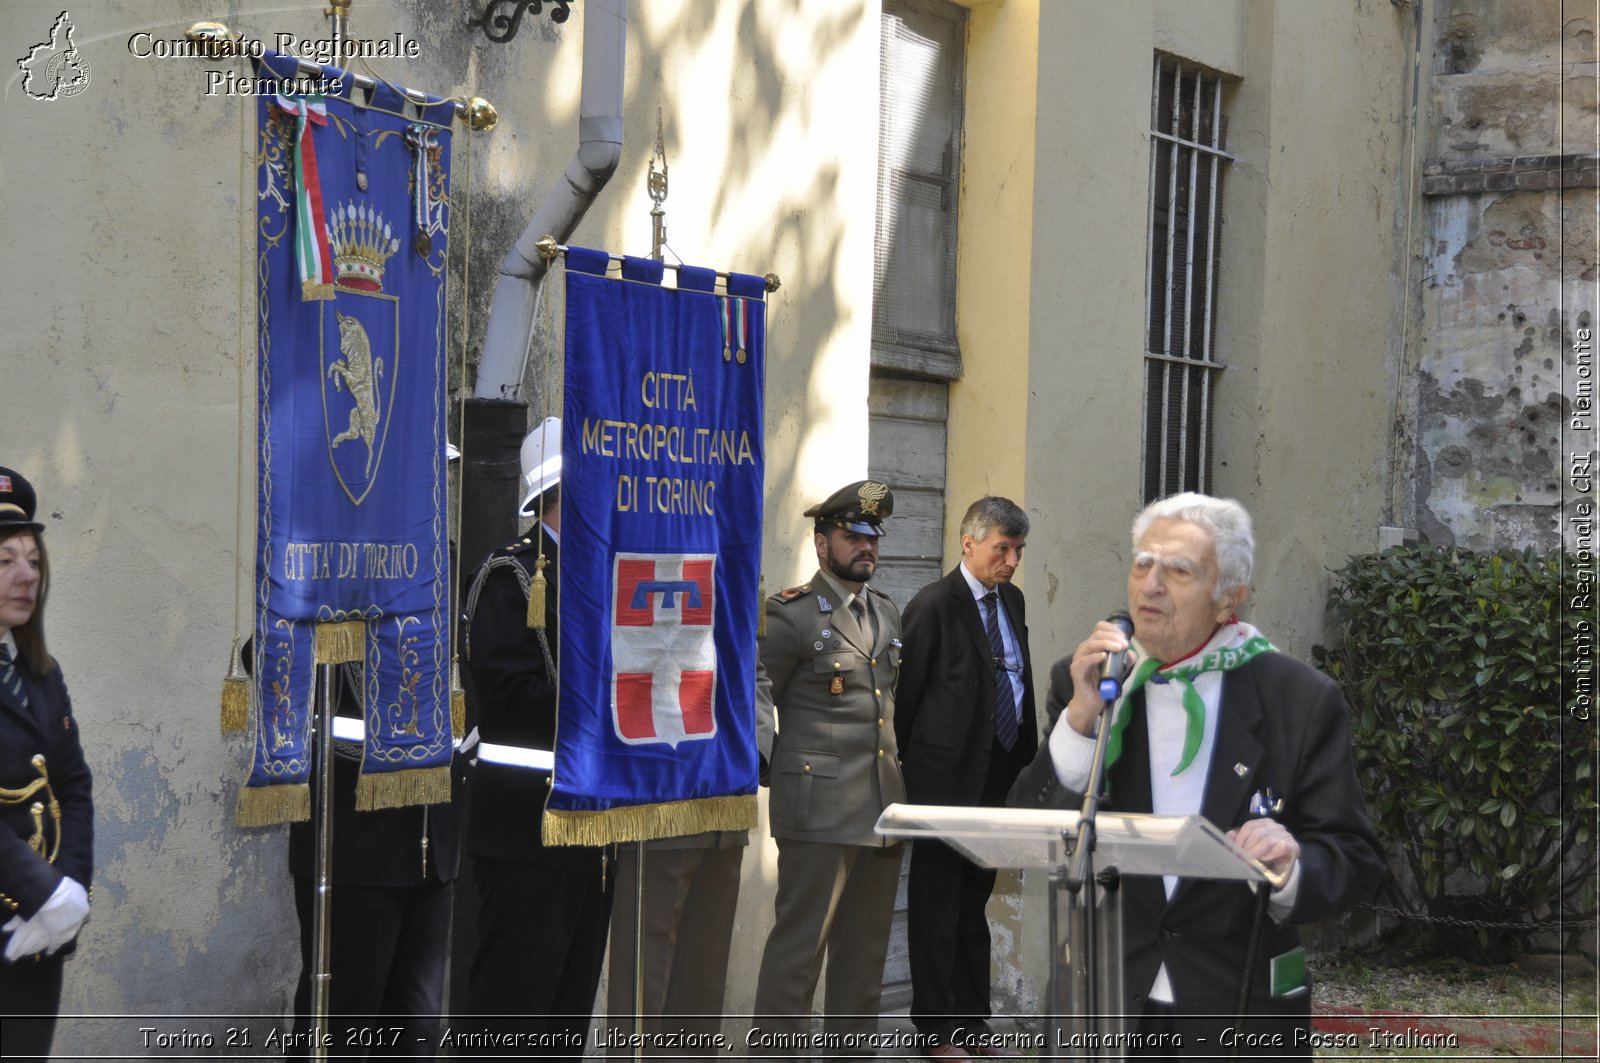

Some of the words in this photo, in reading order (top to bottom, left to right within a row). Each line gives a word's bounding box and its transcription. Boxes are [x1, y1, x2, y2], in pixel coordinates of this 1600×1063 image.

[641, 368, 697, 412] CITTÀ
[582, 417, 755, 465] METROPOLITANA
[617, 475, 638, 513] DI
[646, 476, 715, 516] TORINO
[337, 542, 360, 579] DI
[363, 542, 418, 579] TORINO
